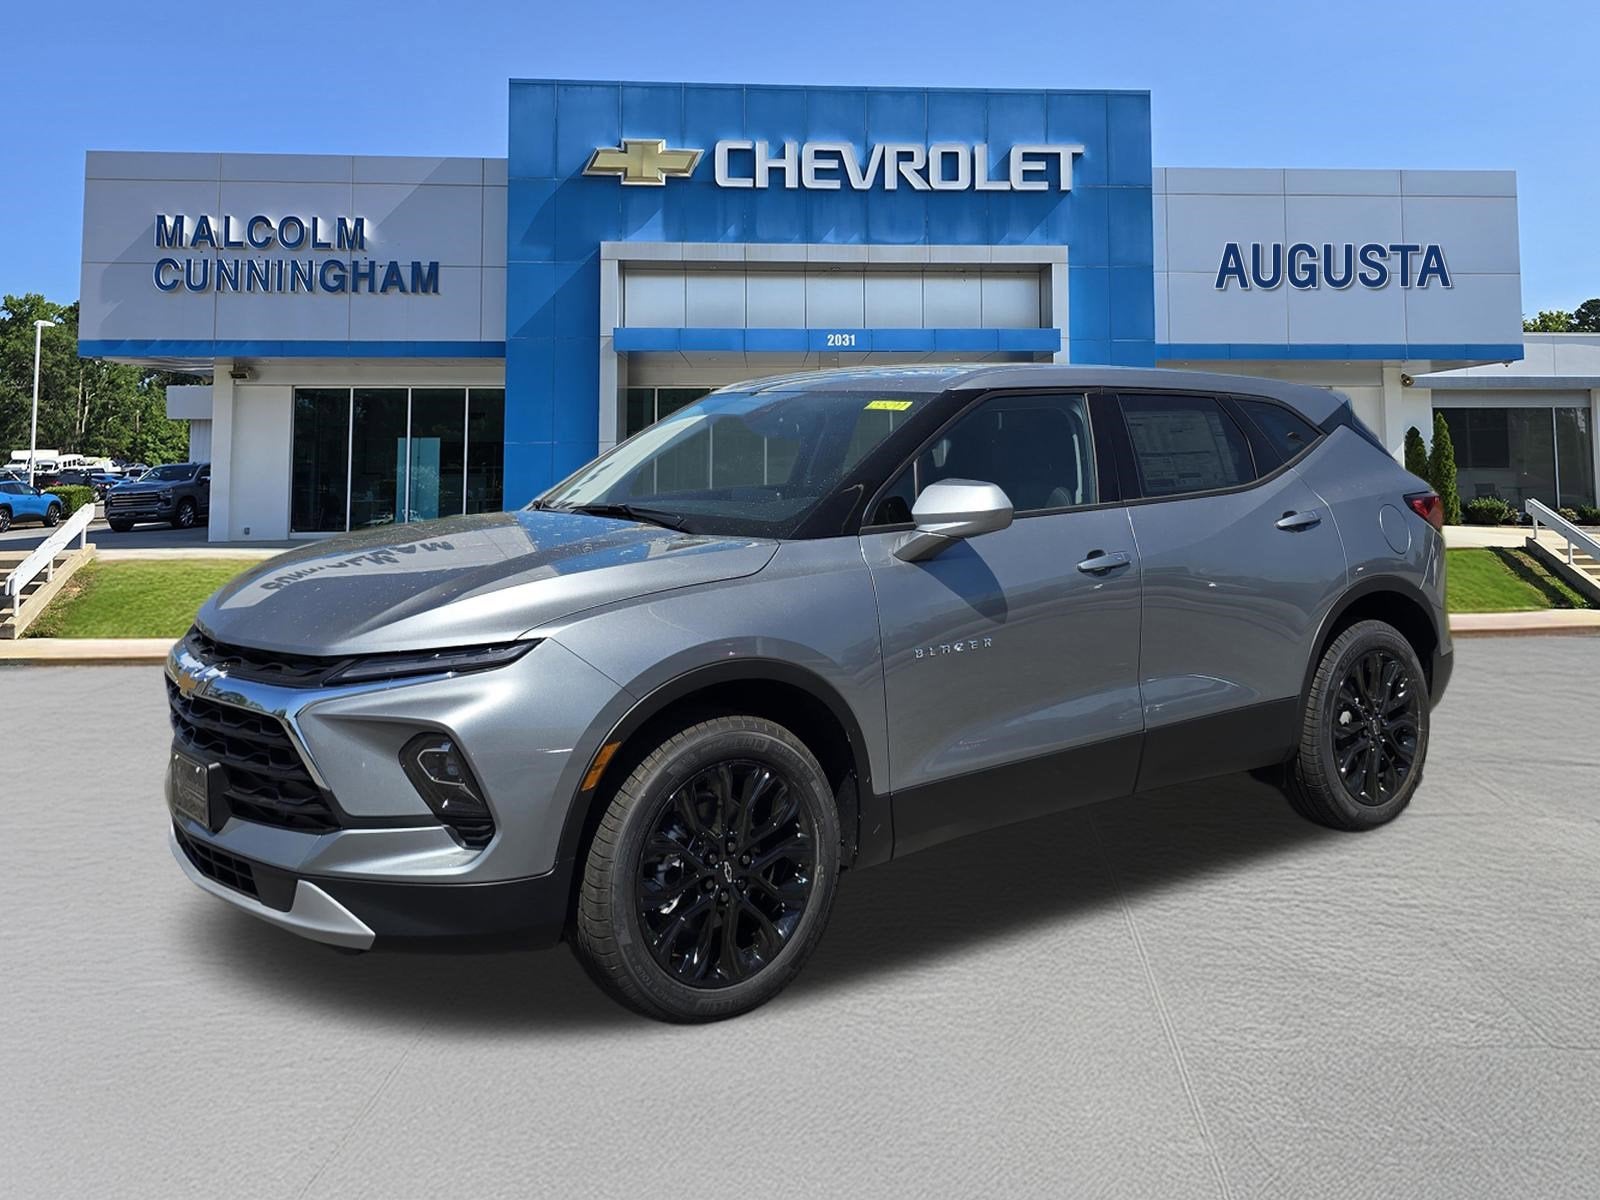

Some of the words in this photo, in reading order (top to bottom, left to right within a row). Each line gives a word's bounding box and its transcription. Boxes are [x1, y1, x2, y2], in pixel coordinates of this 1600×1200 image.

[714, 139, 1085, 192] CHEVROLET
[154, 213, 367, 251] MALCOLM
[153, 257, 441, 294] CUNNINGHAM
[1214, 242, 1452, 290] AUGUSTA
[827, 333, 856, 347] 2031
